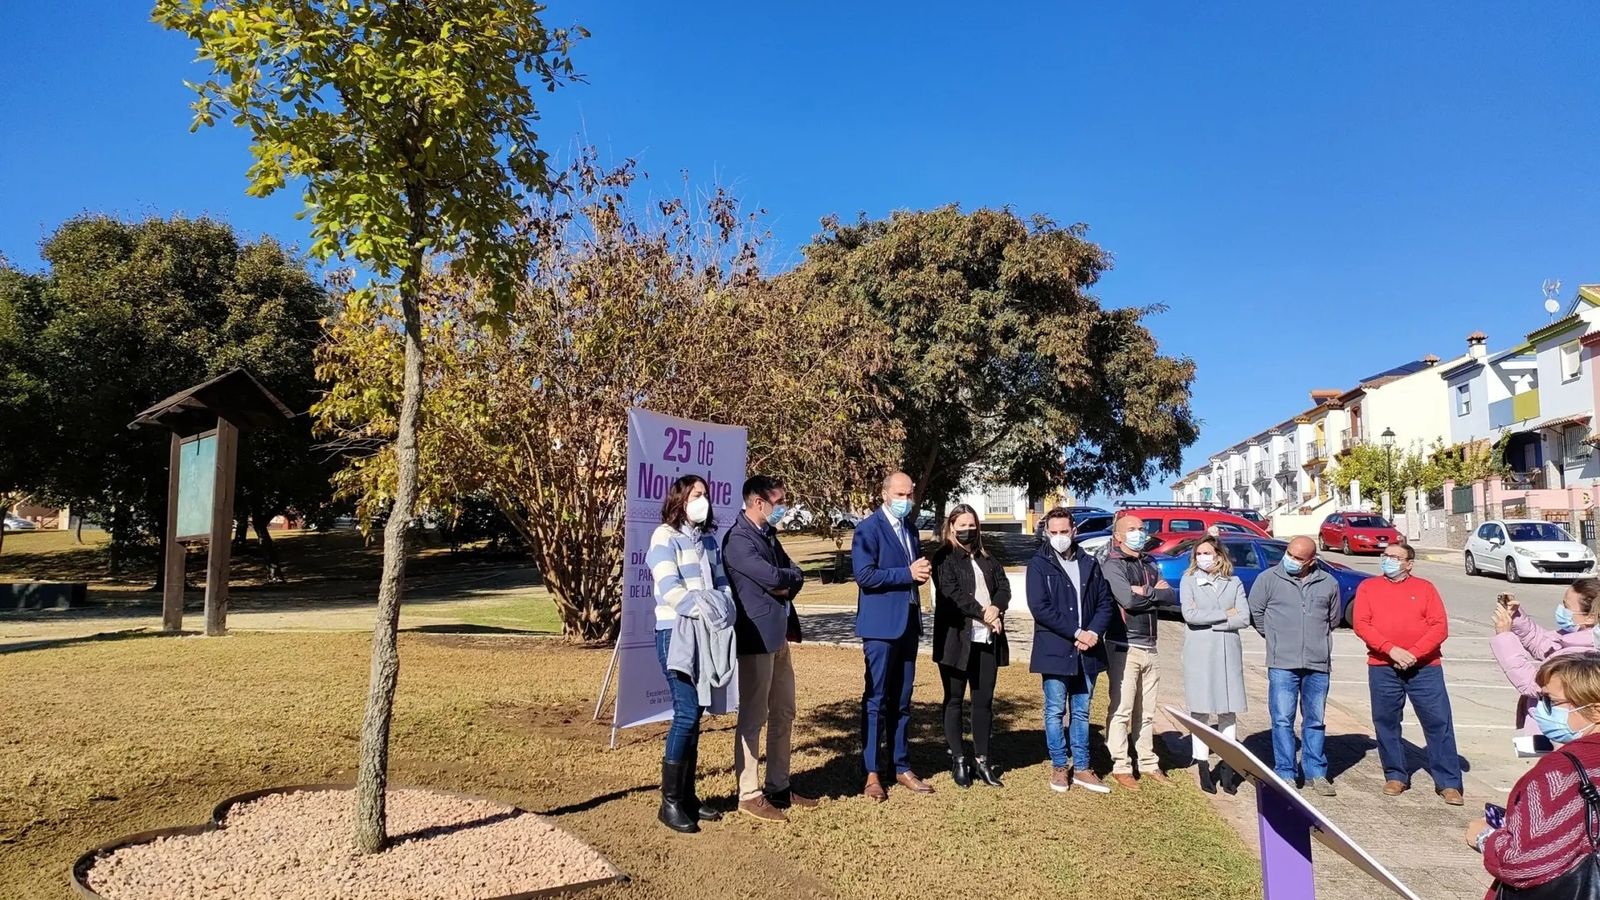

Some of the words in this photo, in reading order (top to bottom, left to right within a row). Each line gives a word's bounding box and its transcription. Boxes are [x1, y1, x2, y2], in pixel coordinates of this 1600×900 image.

[663, 427, 691, 463] 25
[697, 432, 714, 466] de
[638, 462, 732, 505] Novbre
[630, 585, 640, 598] DE
[641, 585, 652, 598] LA
